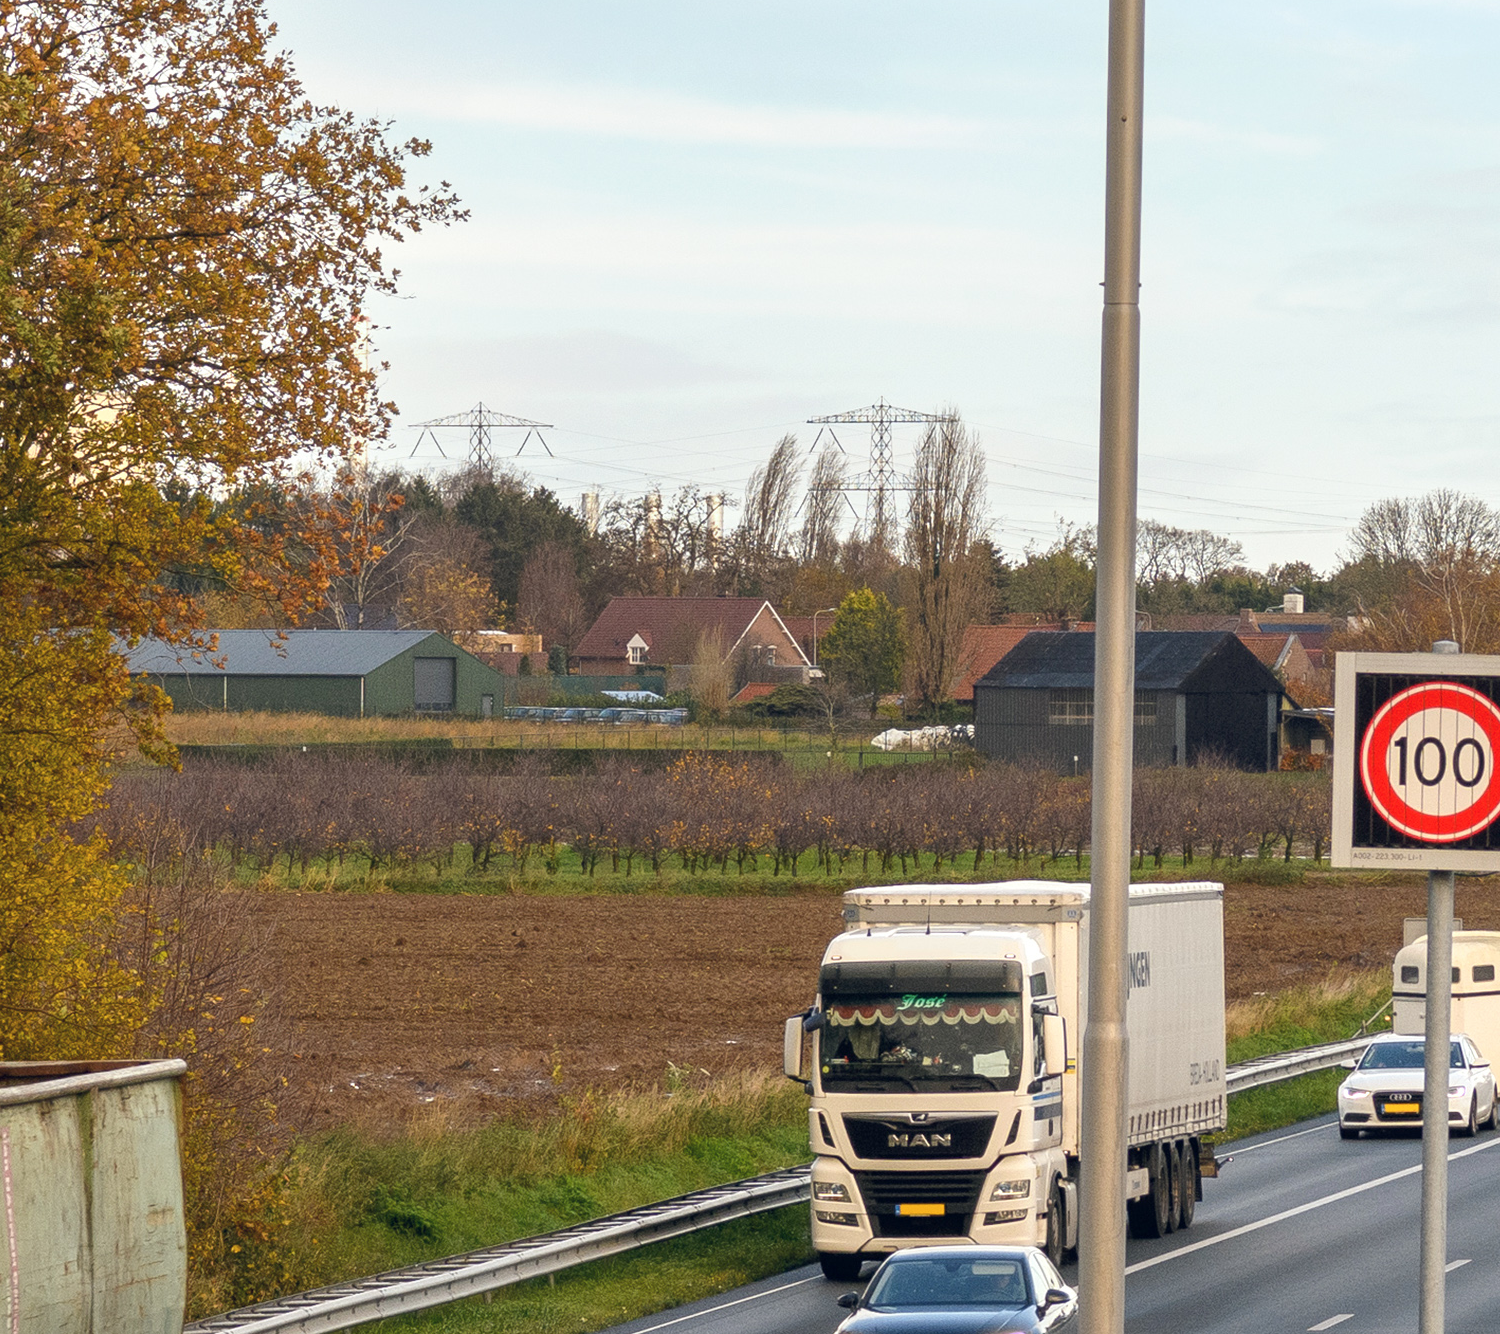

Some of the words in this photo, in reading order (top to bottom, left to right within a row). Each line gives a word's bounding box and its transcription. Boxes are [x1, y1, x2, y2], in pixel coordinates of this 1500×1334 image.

[1393, 736, 1485, 787] 100
[897, 992, 947, 1011] José
[887, 1133, 952, 1147] MAN
